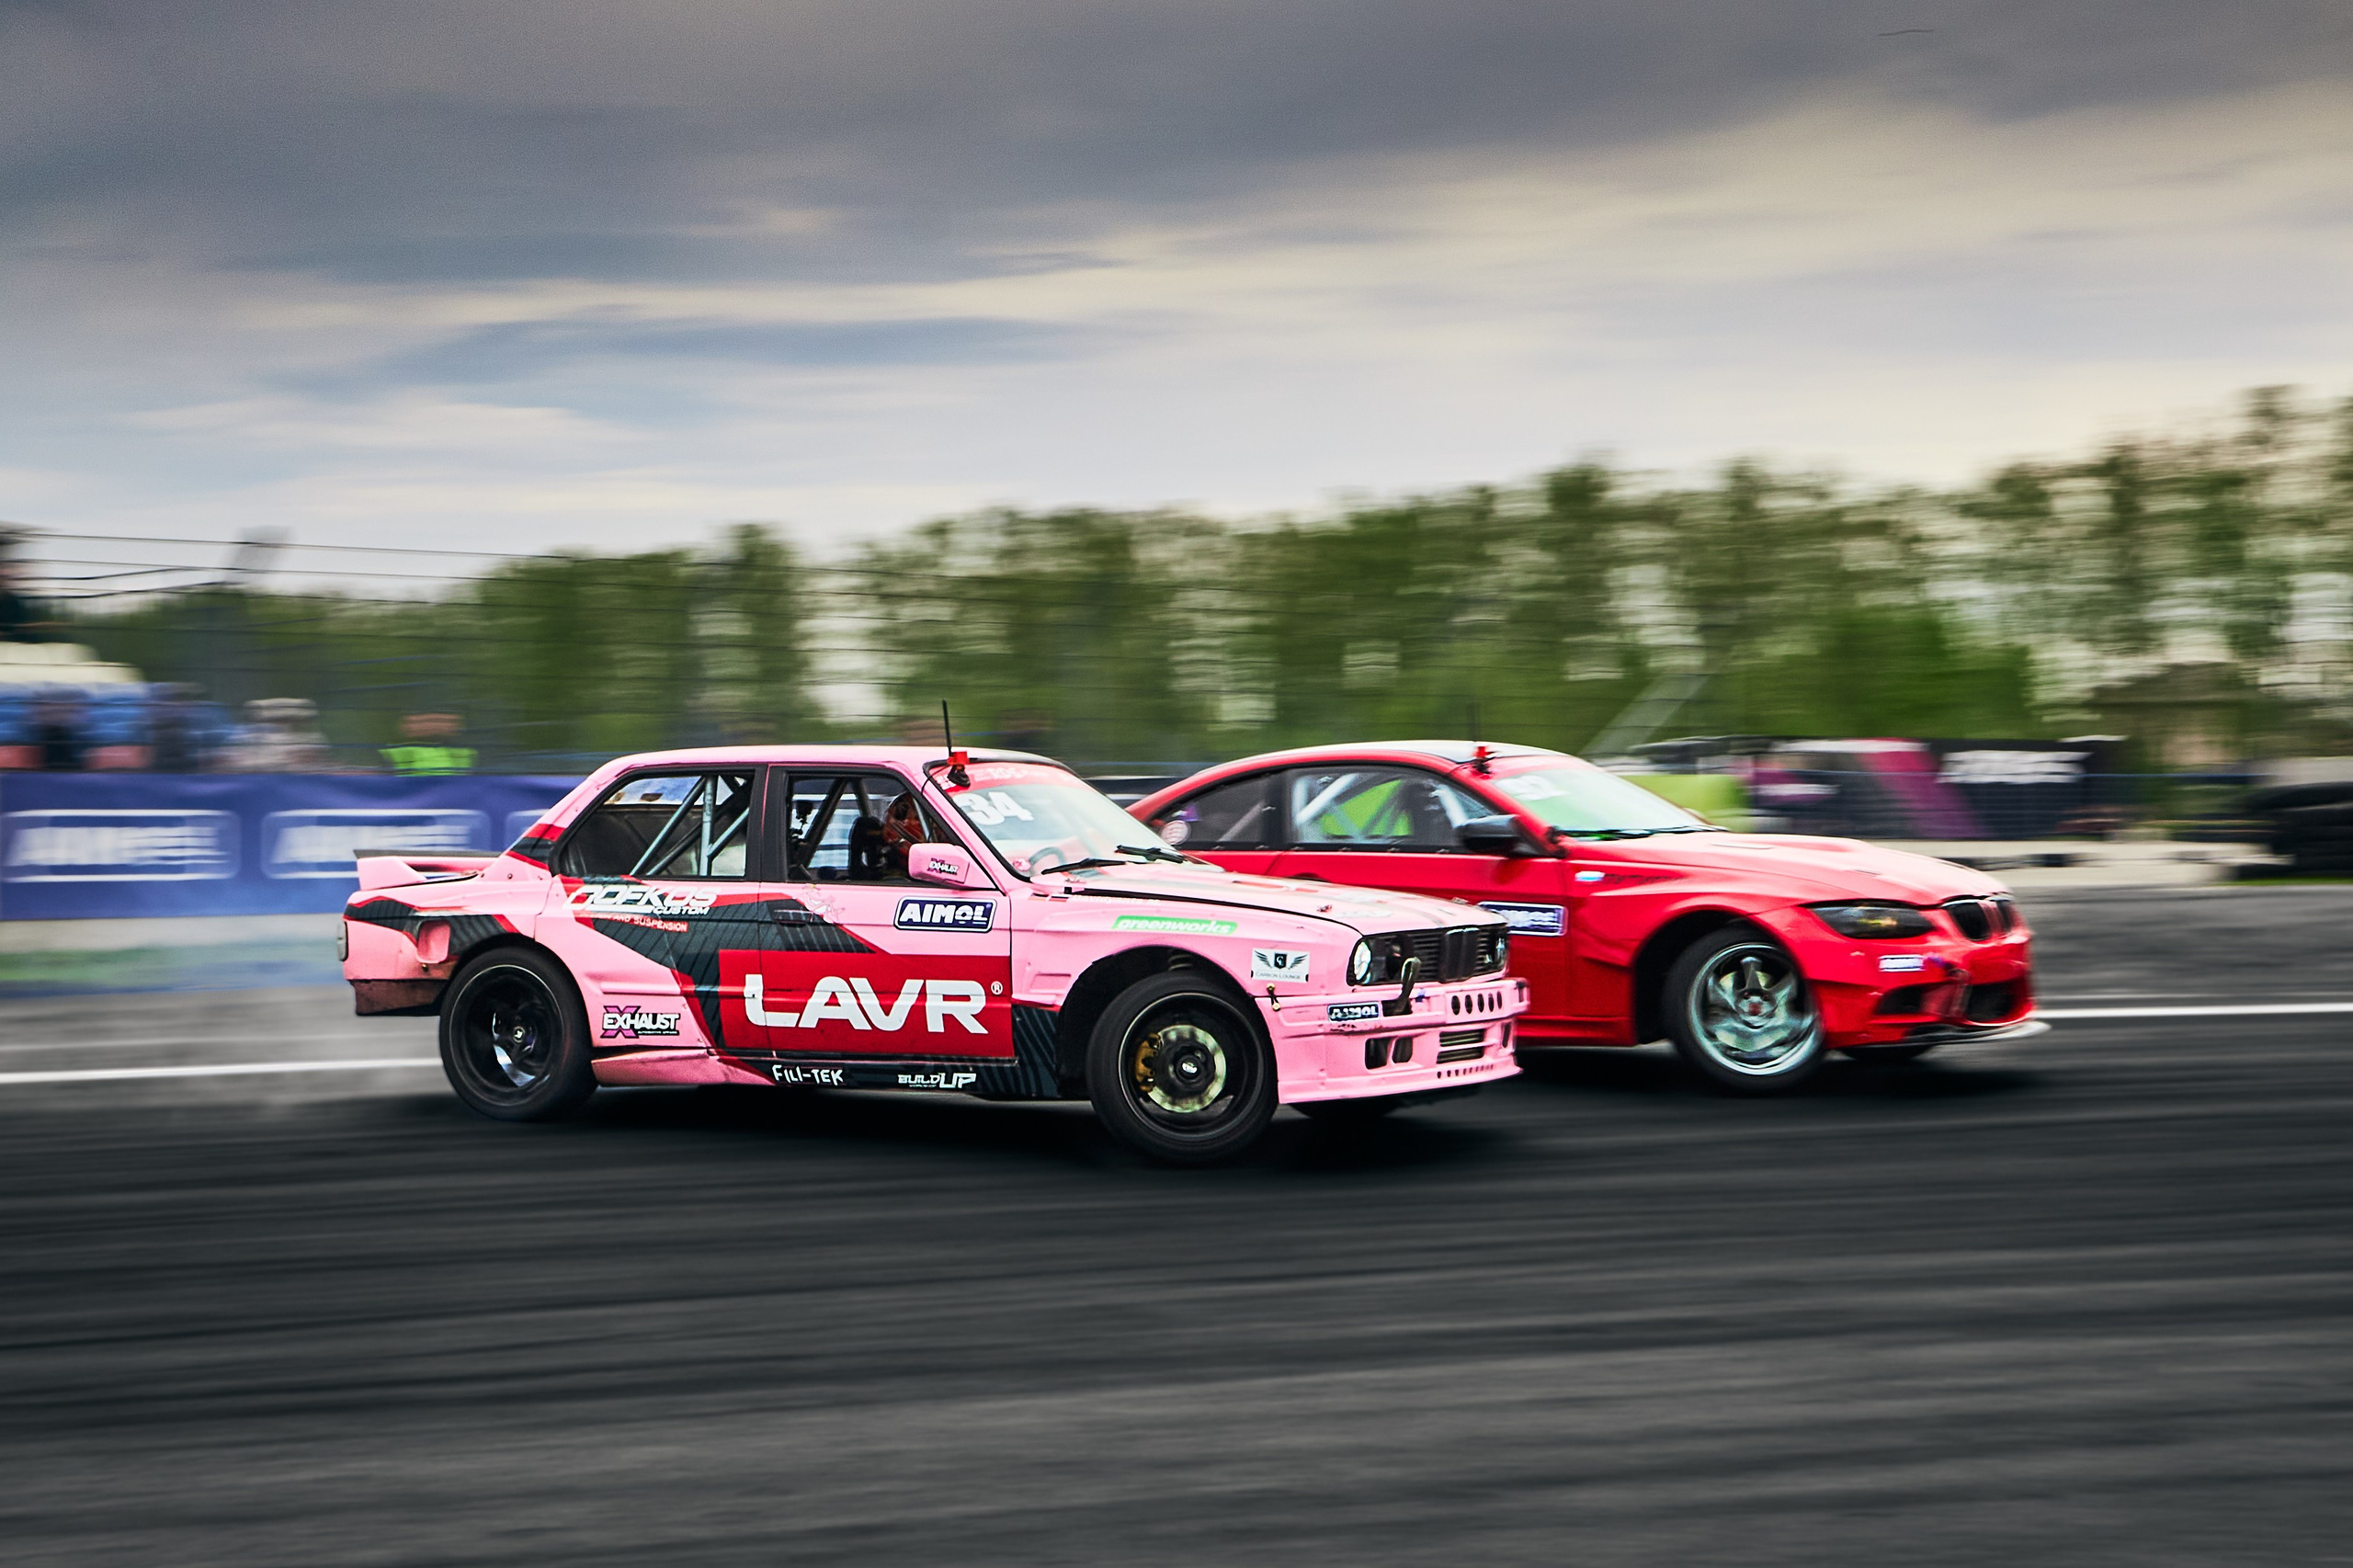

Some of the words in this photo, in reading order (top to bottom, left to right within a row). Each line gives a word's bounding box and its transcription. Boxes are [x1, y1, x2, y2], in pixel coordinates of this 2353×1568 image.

[953, 791, 1034, 825] 34
[653, 906, 710, 915] CUSTOM
[900, 903, 988, 924] AIMOL
[633, 916, 688, 931] SUSPENSION
[1118, 919, 1232, 934] greenworks
[744, 974, 988, 1033] LAVR
[602, 1006, 680, 1037] EXHAUST
